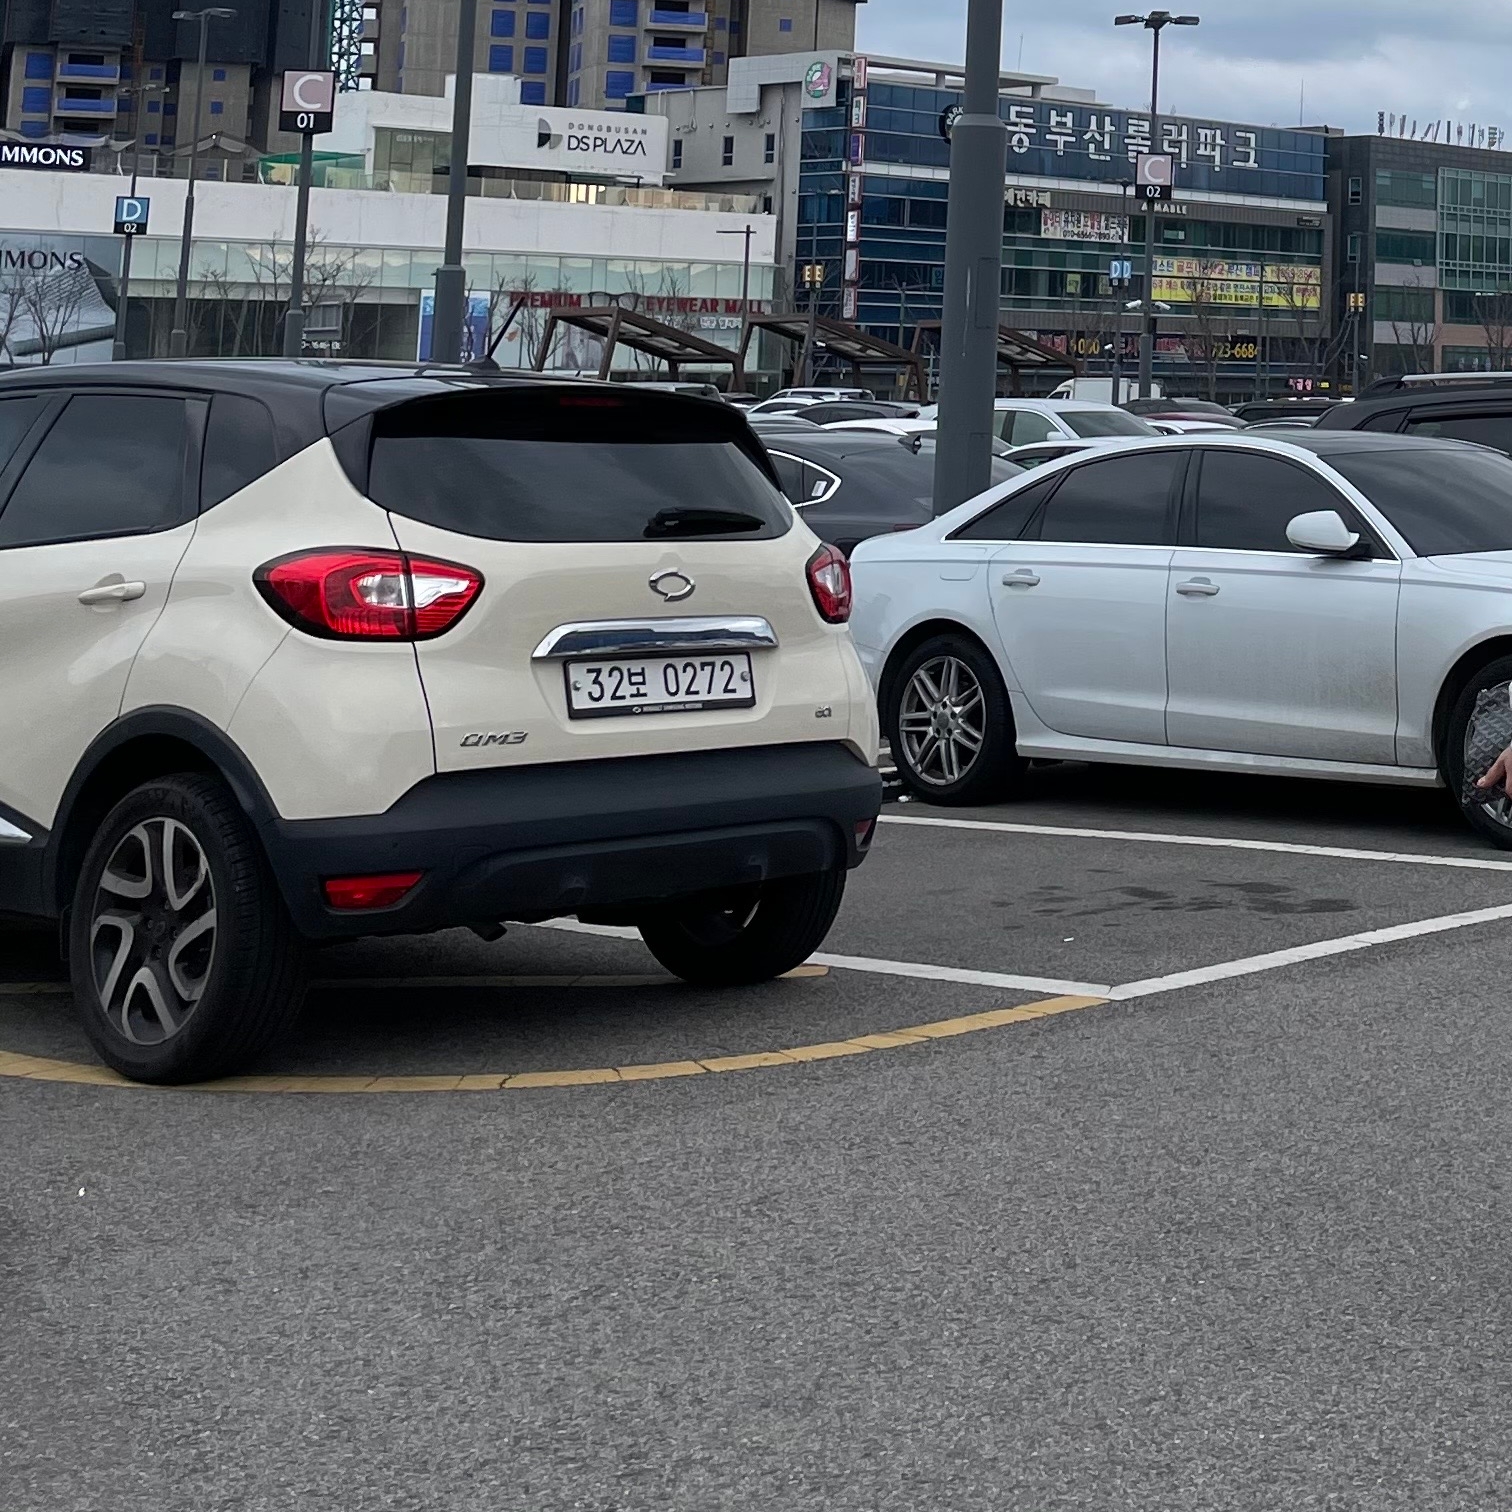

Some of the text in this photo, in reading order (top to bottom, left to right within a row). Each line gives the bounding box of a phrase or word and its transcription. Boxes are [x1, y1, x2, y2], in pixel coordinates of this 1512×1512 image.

[292, 73, 322, 110] C
[296, 112, 316, 129] 01
[946, 106, 964, 126] PARK
[568, 121, 648, 136] DONGBUSAN
[567, 134, 647, 157] DS PLAZA
[1005, 104, 1259, 172] 동부산롤러파크
[1, 145, 84, 167] MMONS
[1143, 156, 1165, 183] C
[1146, 186, 1161, 198] 02
[122, 198, 142, 222] D
[1140, 201, 1188, 215] AMABLE
[123, 223, 138, 234] 02
[0, 249, 83, 271] MONS
[804, 265, 812, 281] E
[815, 265, 822, 281] E
[1112, 261, 1121, 278] D
[1123, 261, 1131, 278] D
[510, 291, 765, 314] PREMIUM EYEWEAR MALL
[1350, 293, 1356, 307] E
[1359, 293, 1364, 307] E
[586, 659, 738, 703] 32보 0272
[459, 729, 529, 748] QM3
